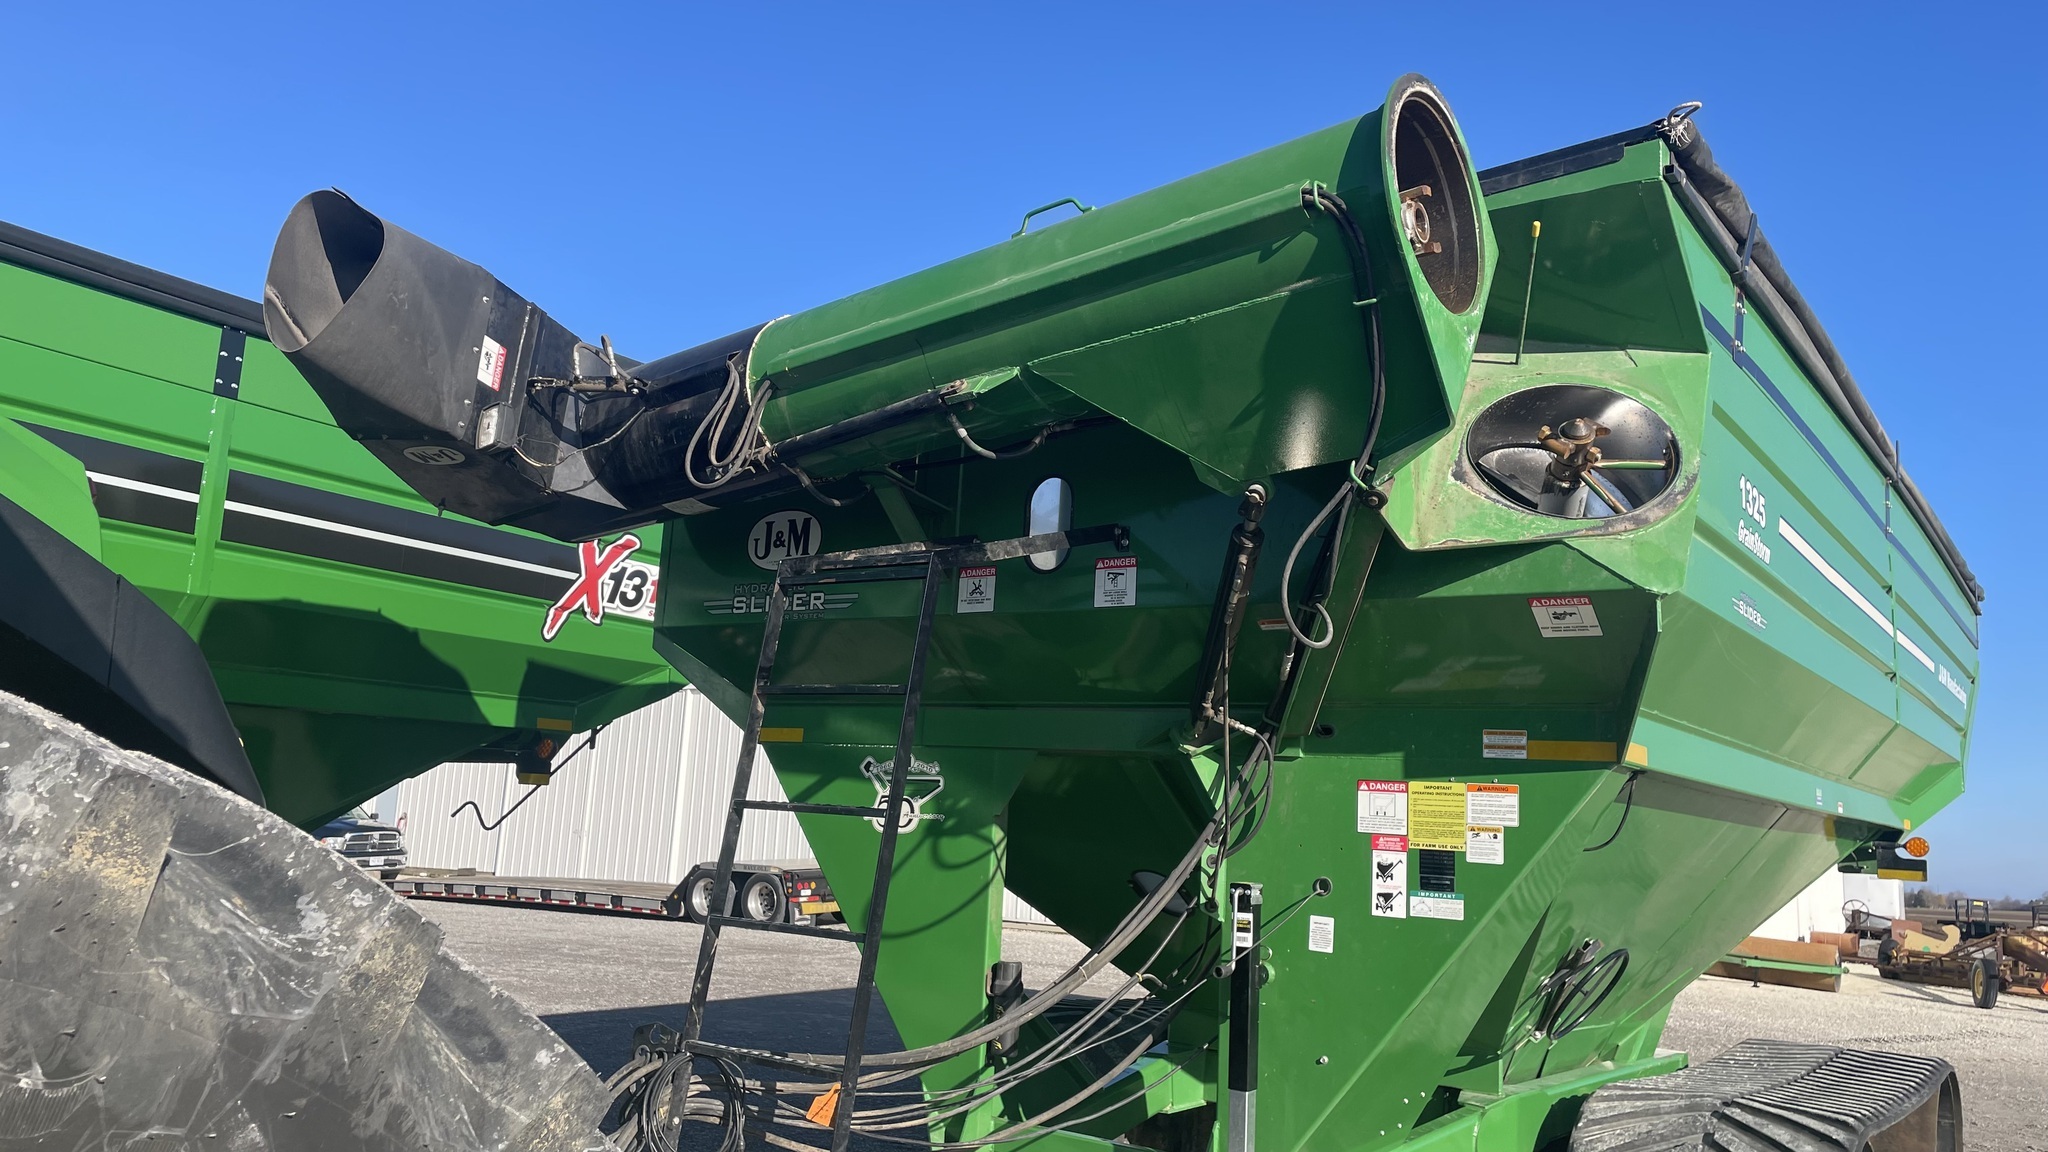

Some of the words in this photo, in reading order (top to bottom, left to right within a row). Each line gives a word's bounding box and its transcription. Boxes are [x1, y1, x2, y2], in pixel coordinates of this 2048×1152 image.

[493, 354, 504, 388] DANGER
[410, 449, 459, 464] J&M
[1739, 475, 1766, 529] 1325
[753, 517, 813, 560] J&M
[1738, 518, 1771, 565] GrainStorm
[1104, 558, 1136, 567] DANGER
[966, 568, 996, 577] DANGER
[1541, 597, 1589, 606] DANGER
[1369, 782, 1406, 791] DANGER
